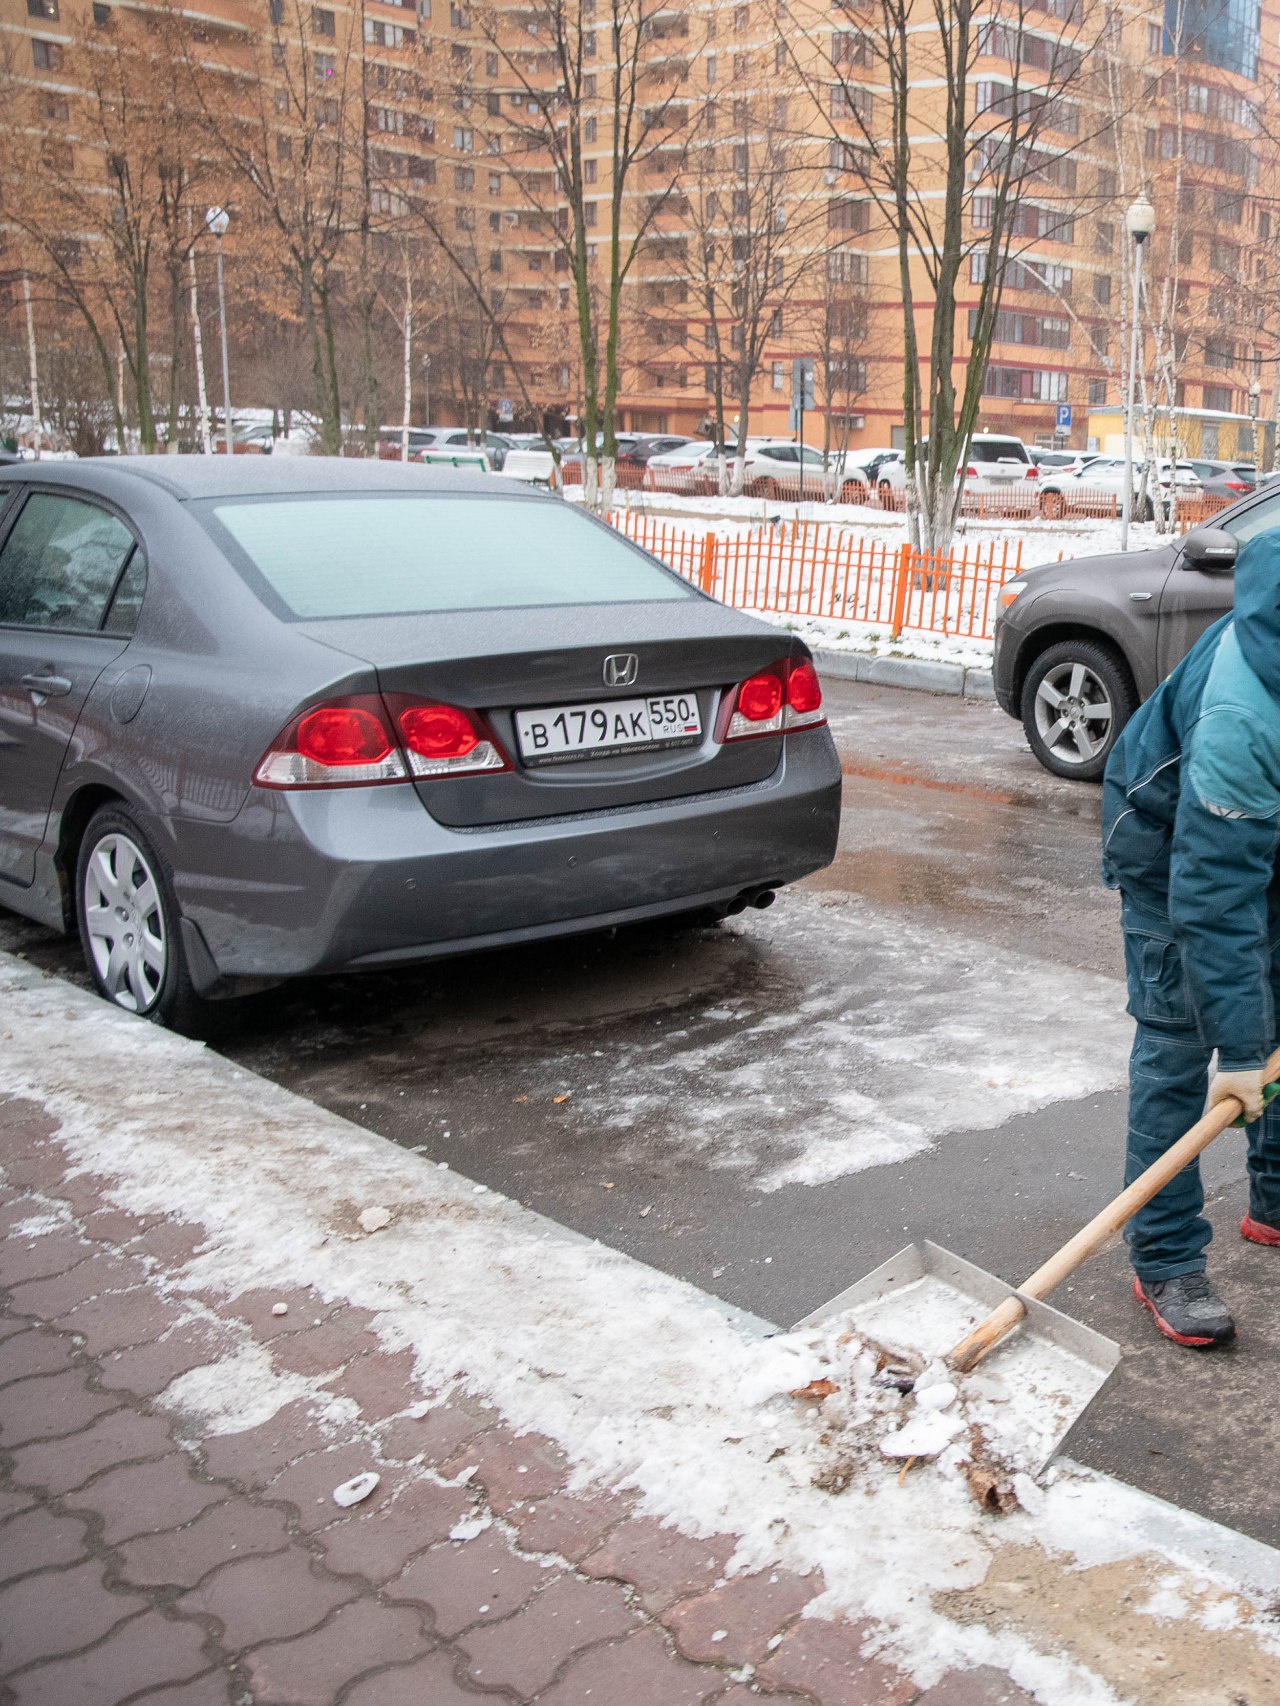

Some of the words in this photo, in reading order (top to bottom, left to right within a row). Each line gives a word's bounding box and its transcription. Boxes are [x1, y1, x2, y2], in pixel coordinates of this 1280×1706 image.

[1059, 406, 1069, 424] P
[531, 708, 647, 749] В179АК
[649, 698, 690, 725] 550
[663, 723, 684, 734] RUS
